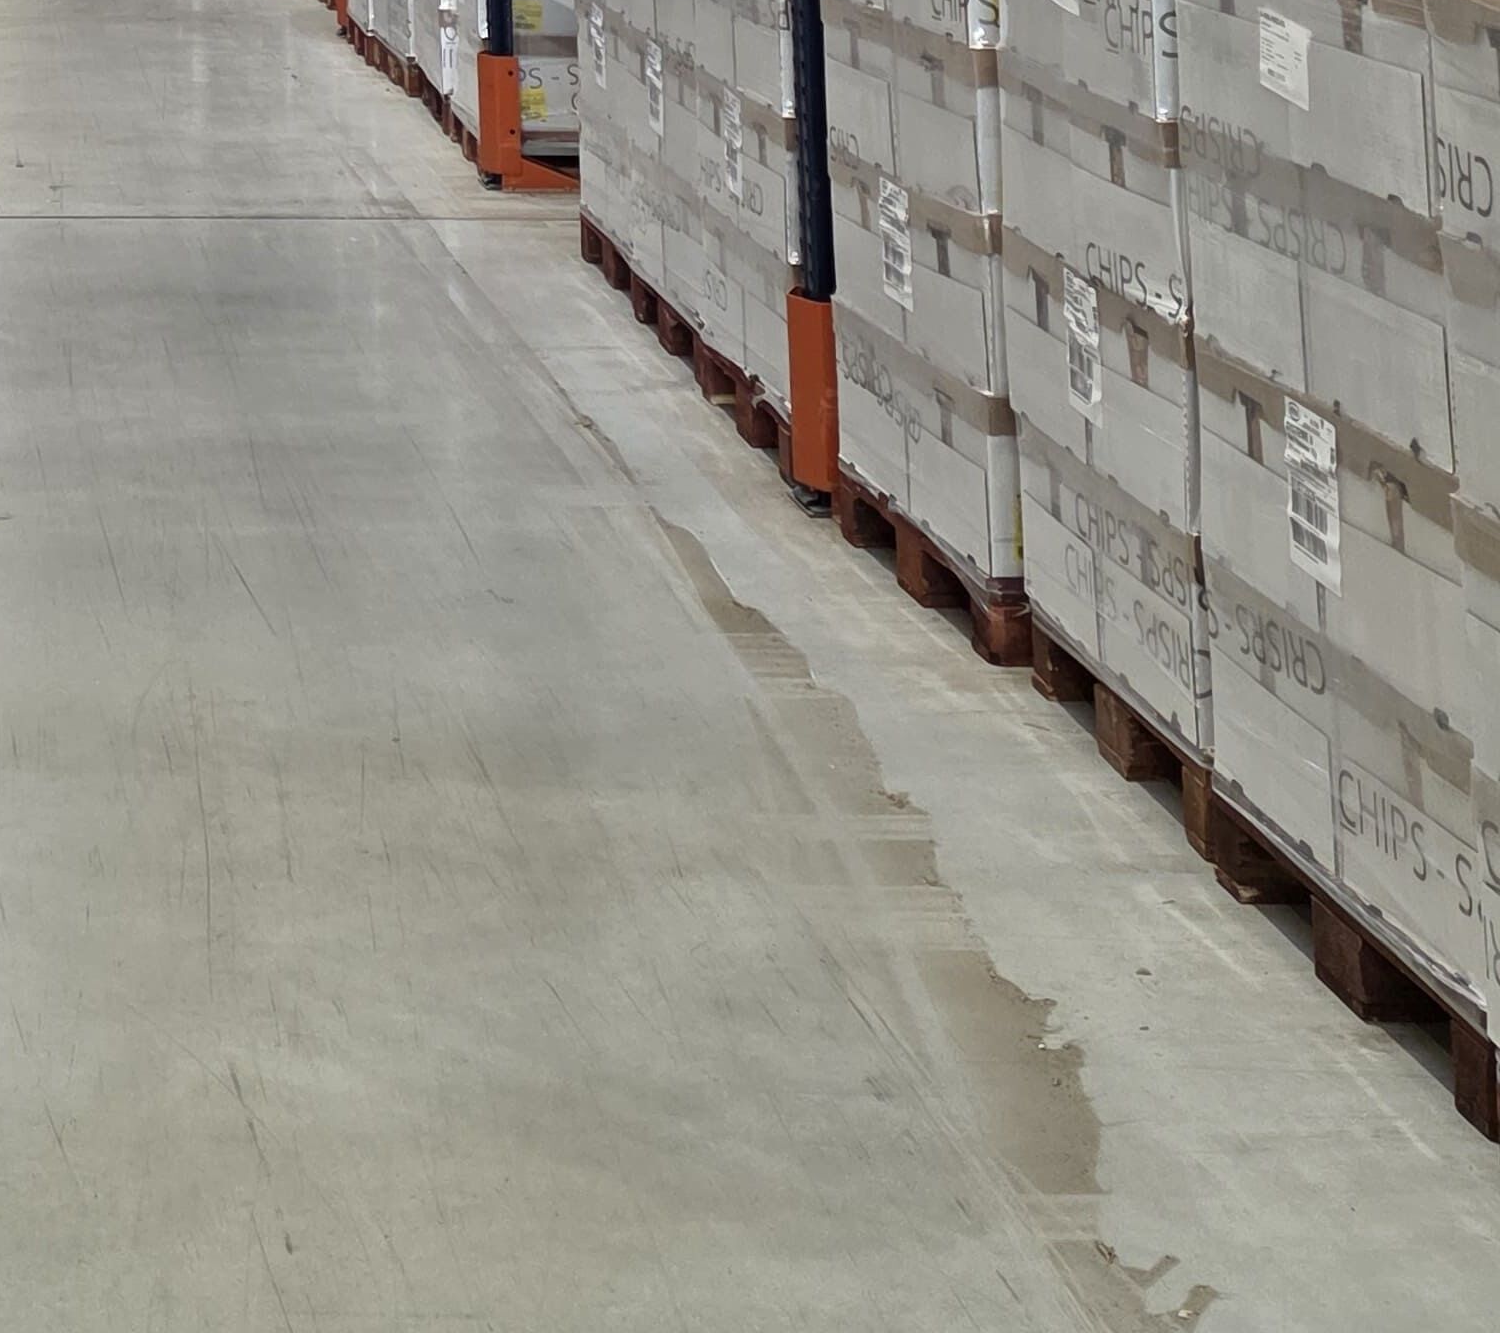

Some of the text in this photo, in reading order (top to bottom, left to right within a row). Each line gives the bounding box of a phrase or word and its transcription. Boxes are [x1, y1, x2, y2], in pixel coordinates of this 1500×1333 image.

[1435, 135, 1494, 218] CRIS
[1086, 241, 1147, 306] CHIPS
[1259, 195, 1347, 276] CRISPS
[1075, 493, 1130, 566] CHIPS
[1234, 603, 1326, 696] CRISPS
[1338, 769, 1428, 882] CHIPS
